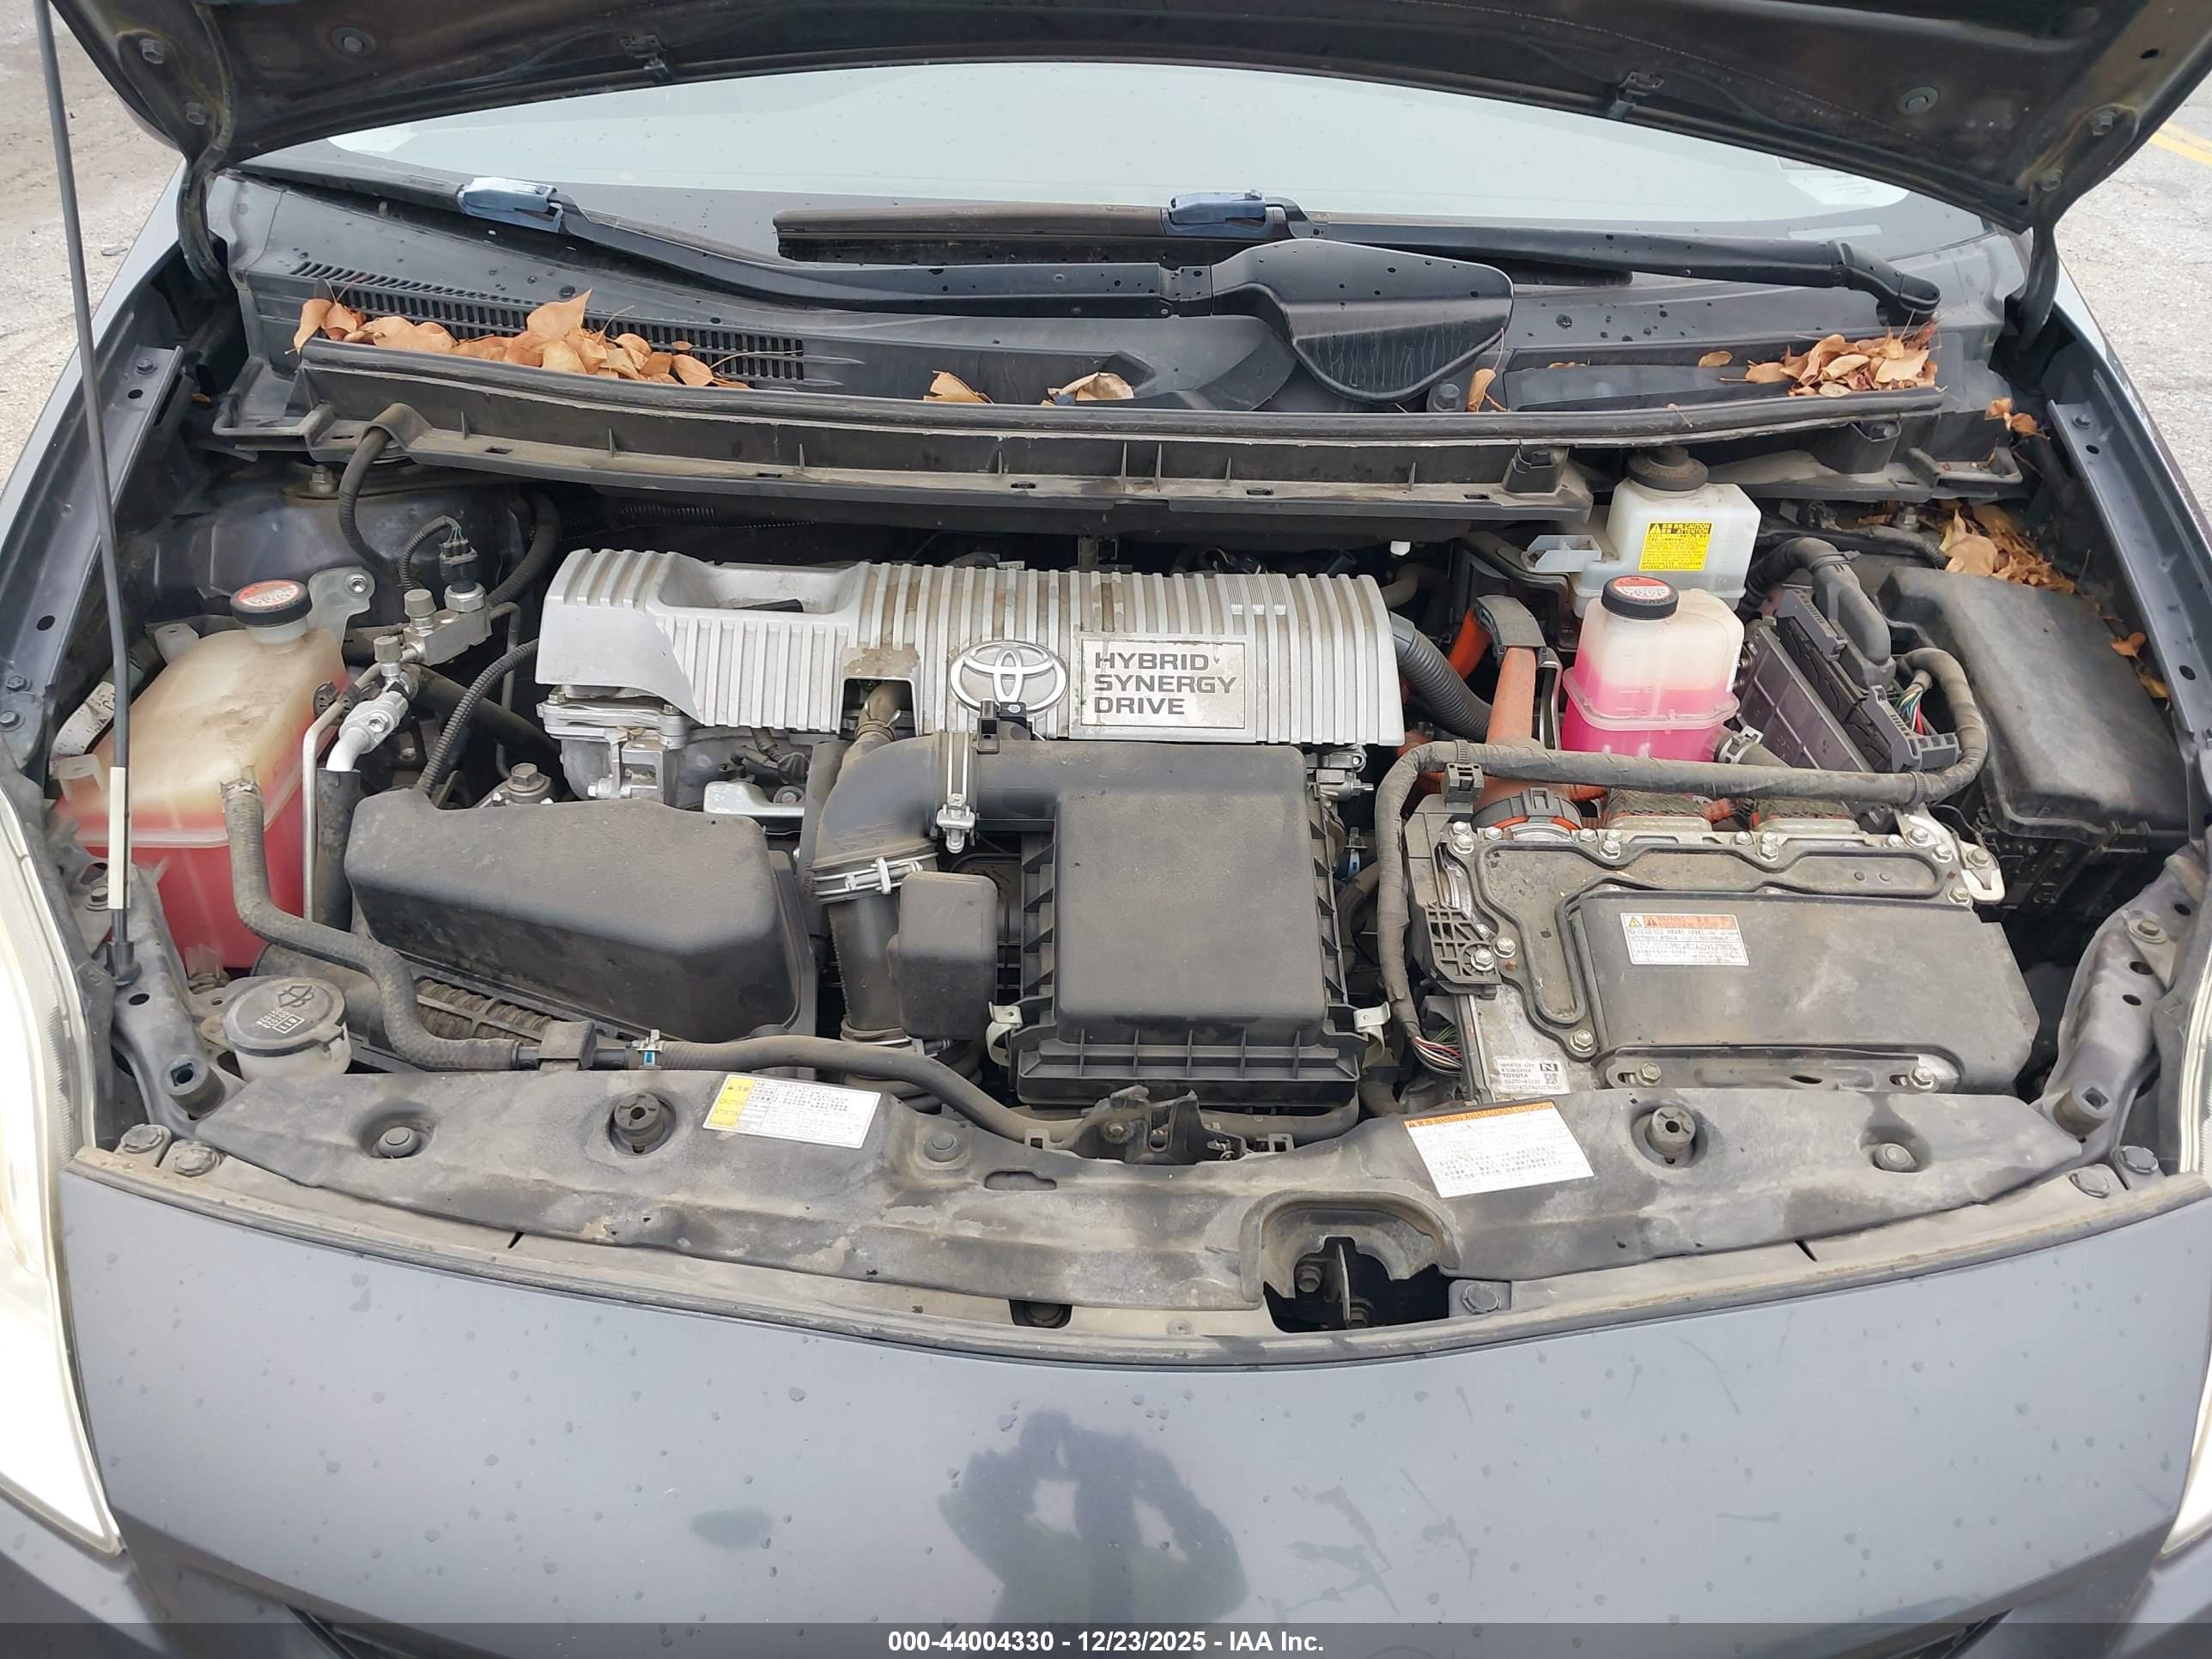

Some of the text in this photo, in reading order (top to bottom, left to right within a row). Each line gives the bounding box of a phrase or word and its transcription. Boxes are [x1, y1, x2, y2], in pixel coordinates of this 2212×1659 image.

[1095, 652, 1209, 671] HYBRID
[1095, 674, 1237, 694] SYNERGY
[1095, 696, 1185, 715] DRIVE
